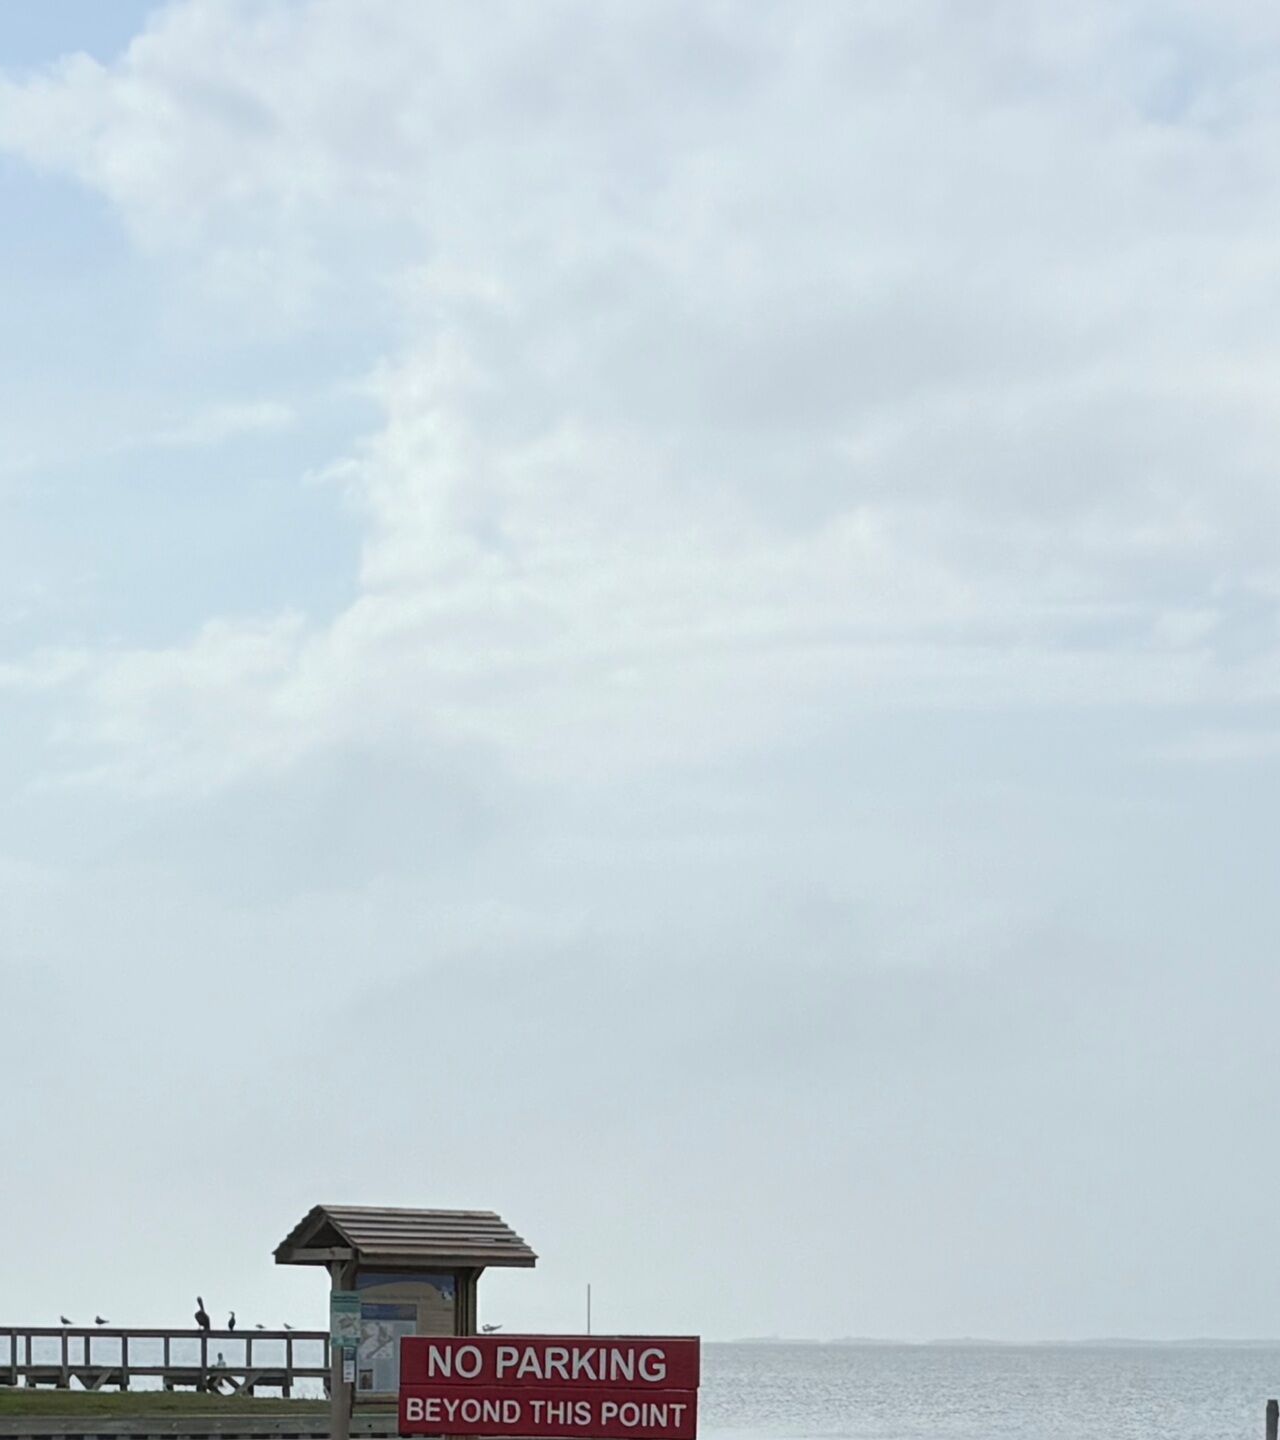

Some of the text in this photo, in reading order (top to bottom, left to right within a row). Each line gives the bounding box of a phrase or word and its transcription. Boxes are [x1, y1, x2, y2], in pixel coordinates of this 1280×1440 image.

[427, 1345, 482, 1379] NO
[496, 1346, 666, 1382] PARKING
[406, 1397, 687, 1428] BEYOND THIS POINT
